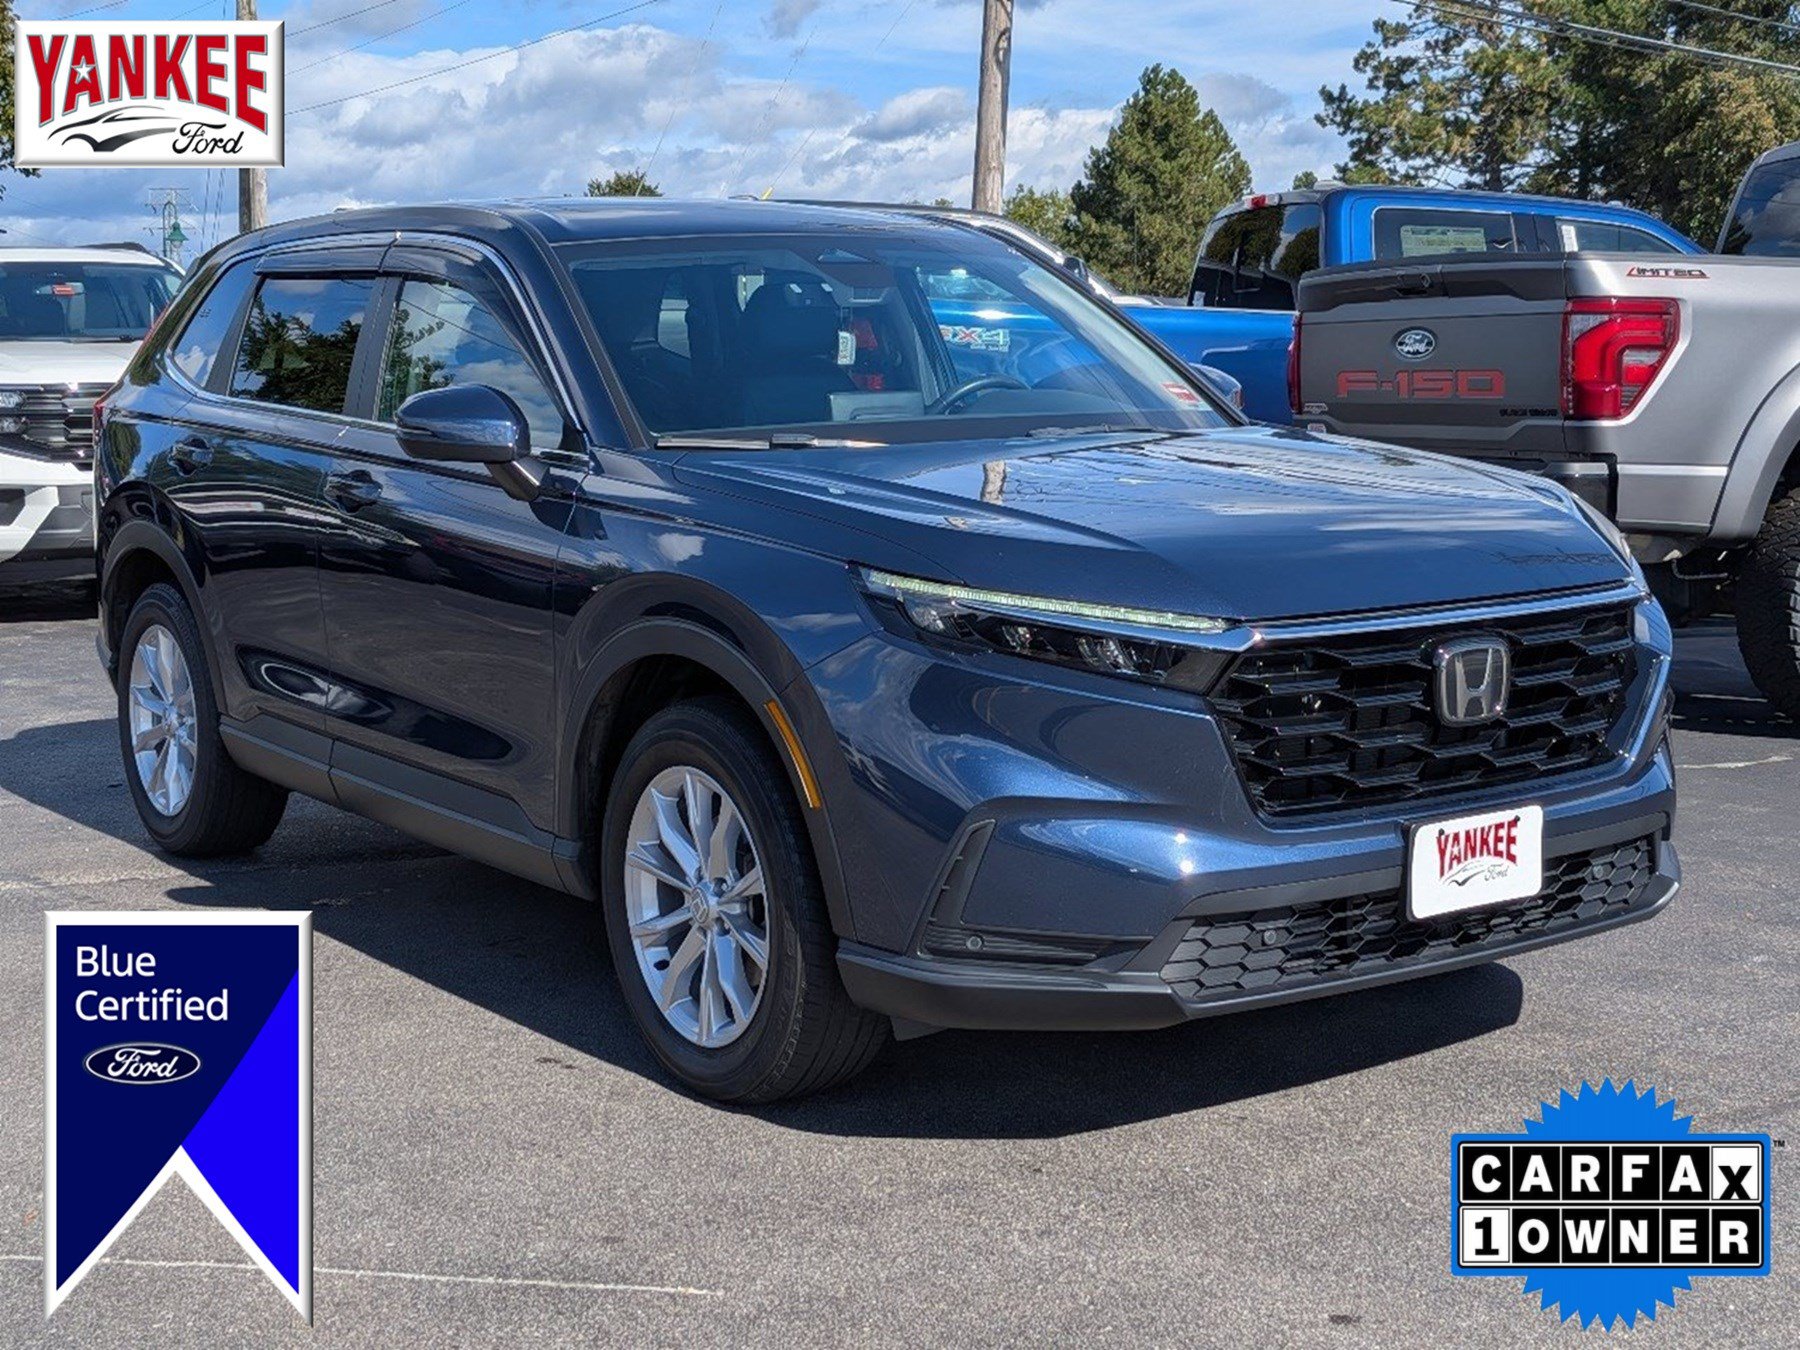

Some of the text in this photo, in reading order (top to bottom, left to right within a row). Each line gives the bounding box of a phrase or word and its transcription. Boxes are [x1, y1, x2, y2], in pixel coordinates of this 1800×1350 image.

[1627, 267, 1710, 278] LIMITED
[1337, 370, 1505, 398] F-150
[1436, 818, 1518, 879] YANKEE
